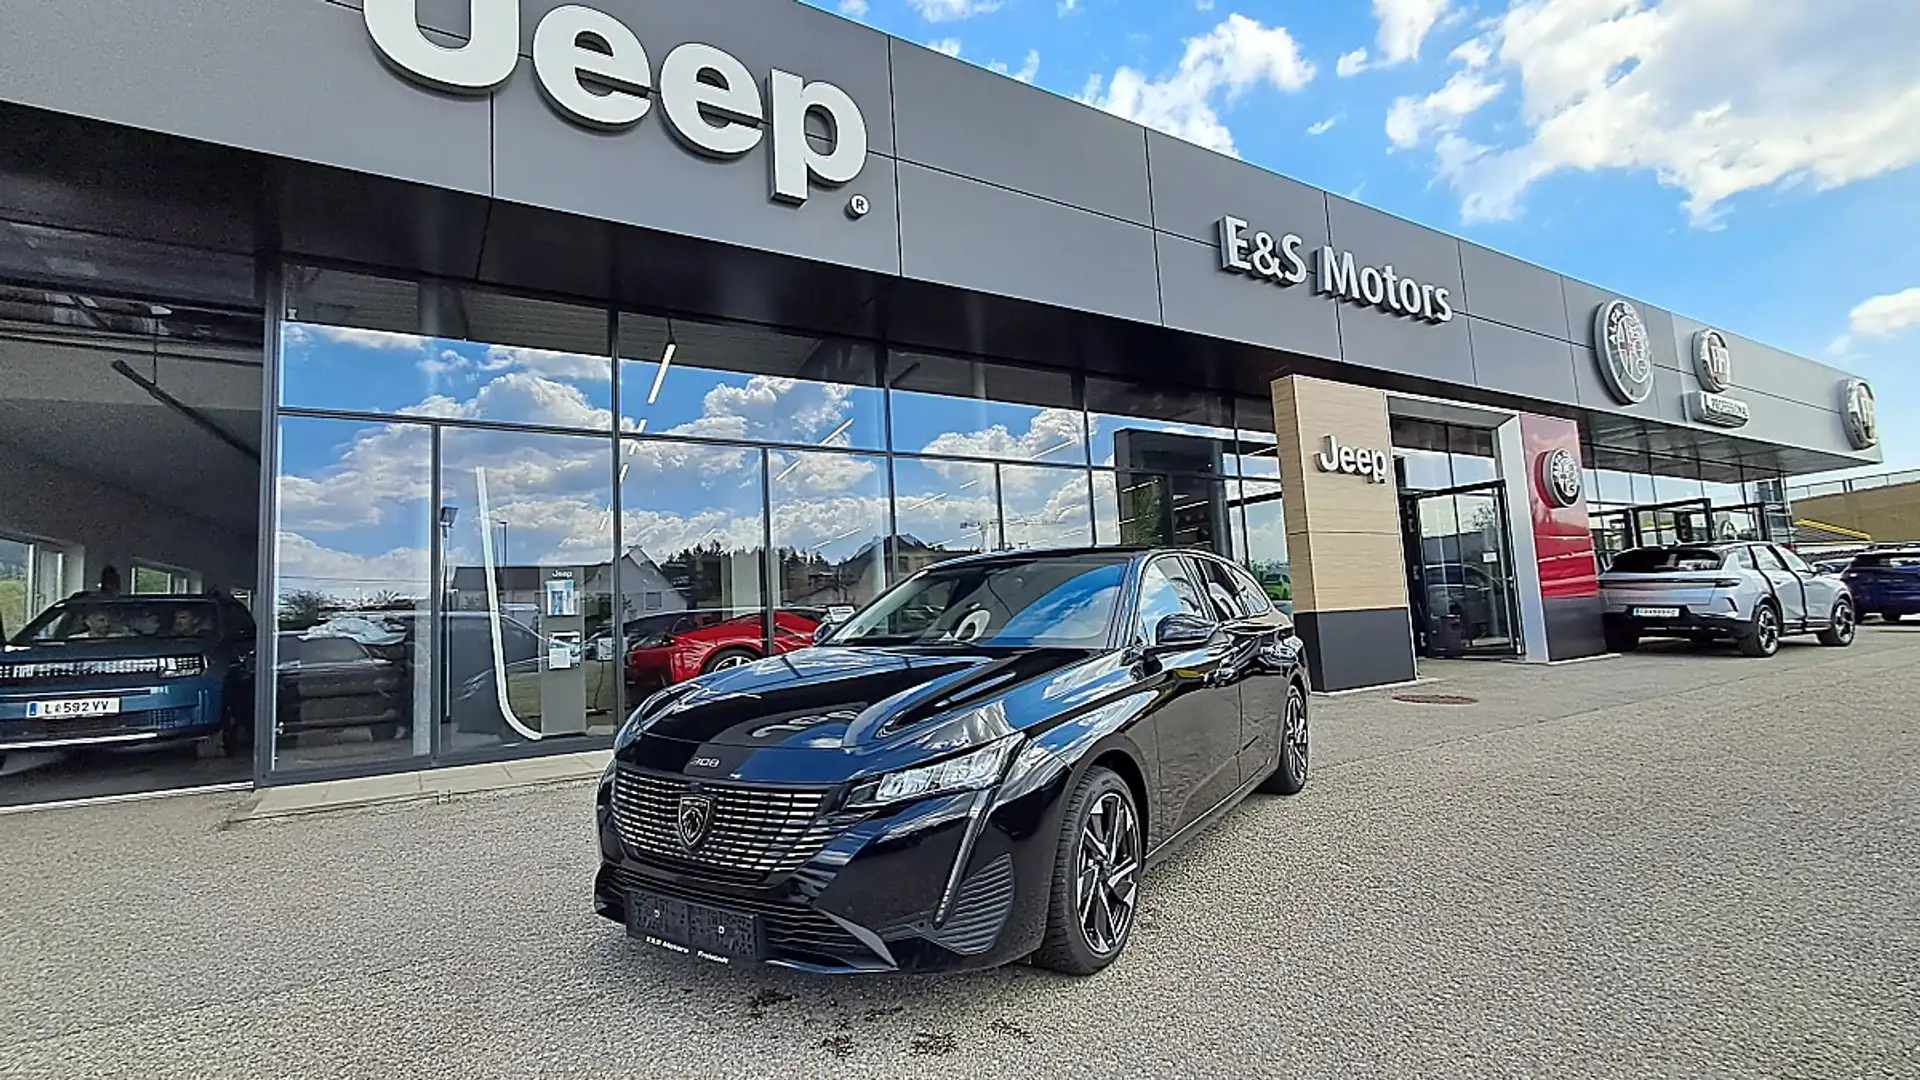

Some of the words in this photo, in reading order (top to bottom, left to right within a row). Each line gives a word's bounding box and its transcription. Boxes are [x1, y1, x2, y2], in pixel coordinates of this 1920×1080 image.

[1218, 214, 1308, 284] E&S
[1317, 245, 1453, 322] Motors
[1318, 434, 1388, 483] Jeep
[551, 570, 573, 578] Jeep
[690, 756, 720, 768] 308
